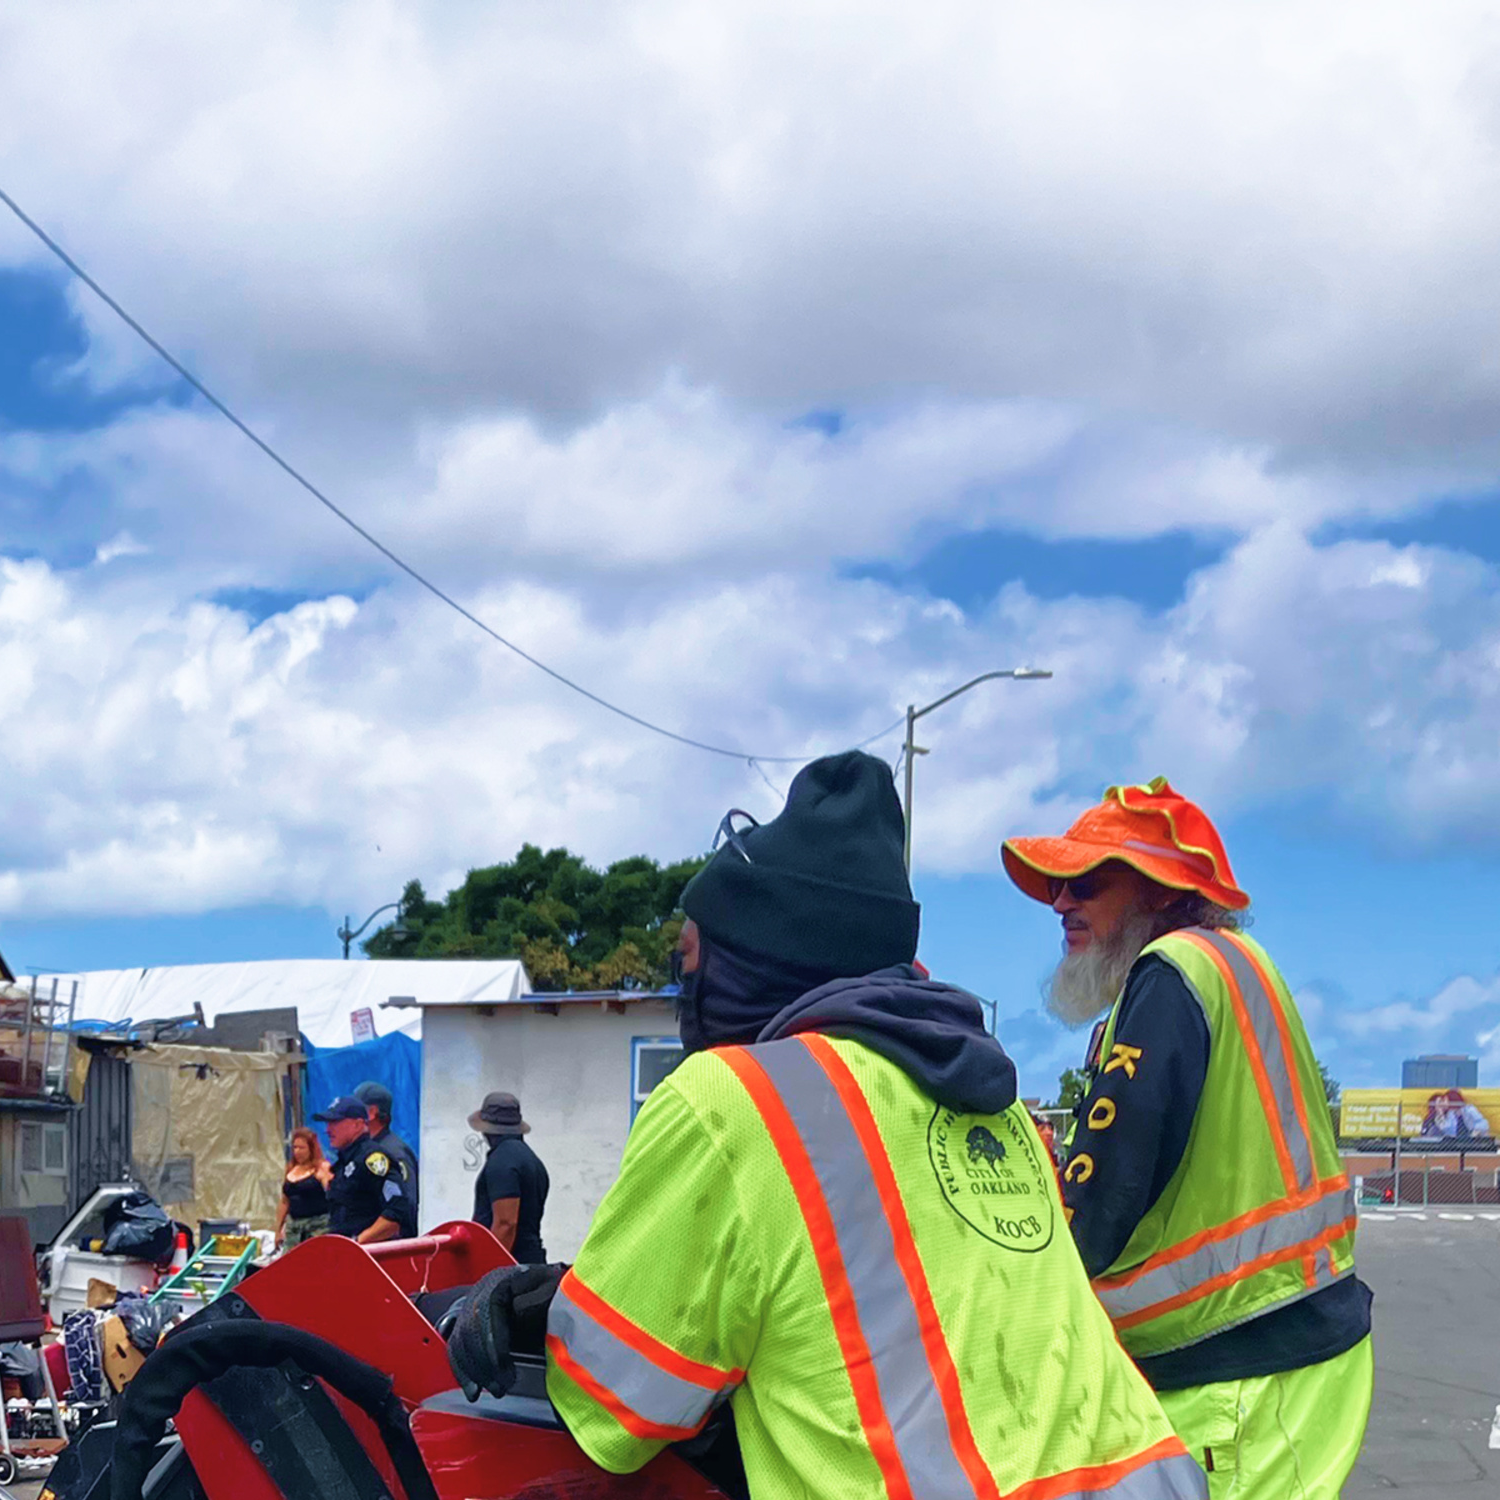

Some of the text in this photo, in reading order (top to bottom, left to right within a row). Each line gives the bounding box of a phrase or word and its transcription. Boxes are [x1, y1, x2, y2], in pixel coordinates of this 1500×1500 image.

[1064, 1043, 1143, 1224] KOC
[970, 1182, 1031, 1195] OAKLAND
[994, 1215, 1042, 1239] KOCB
